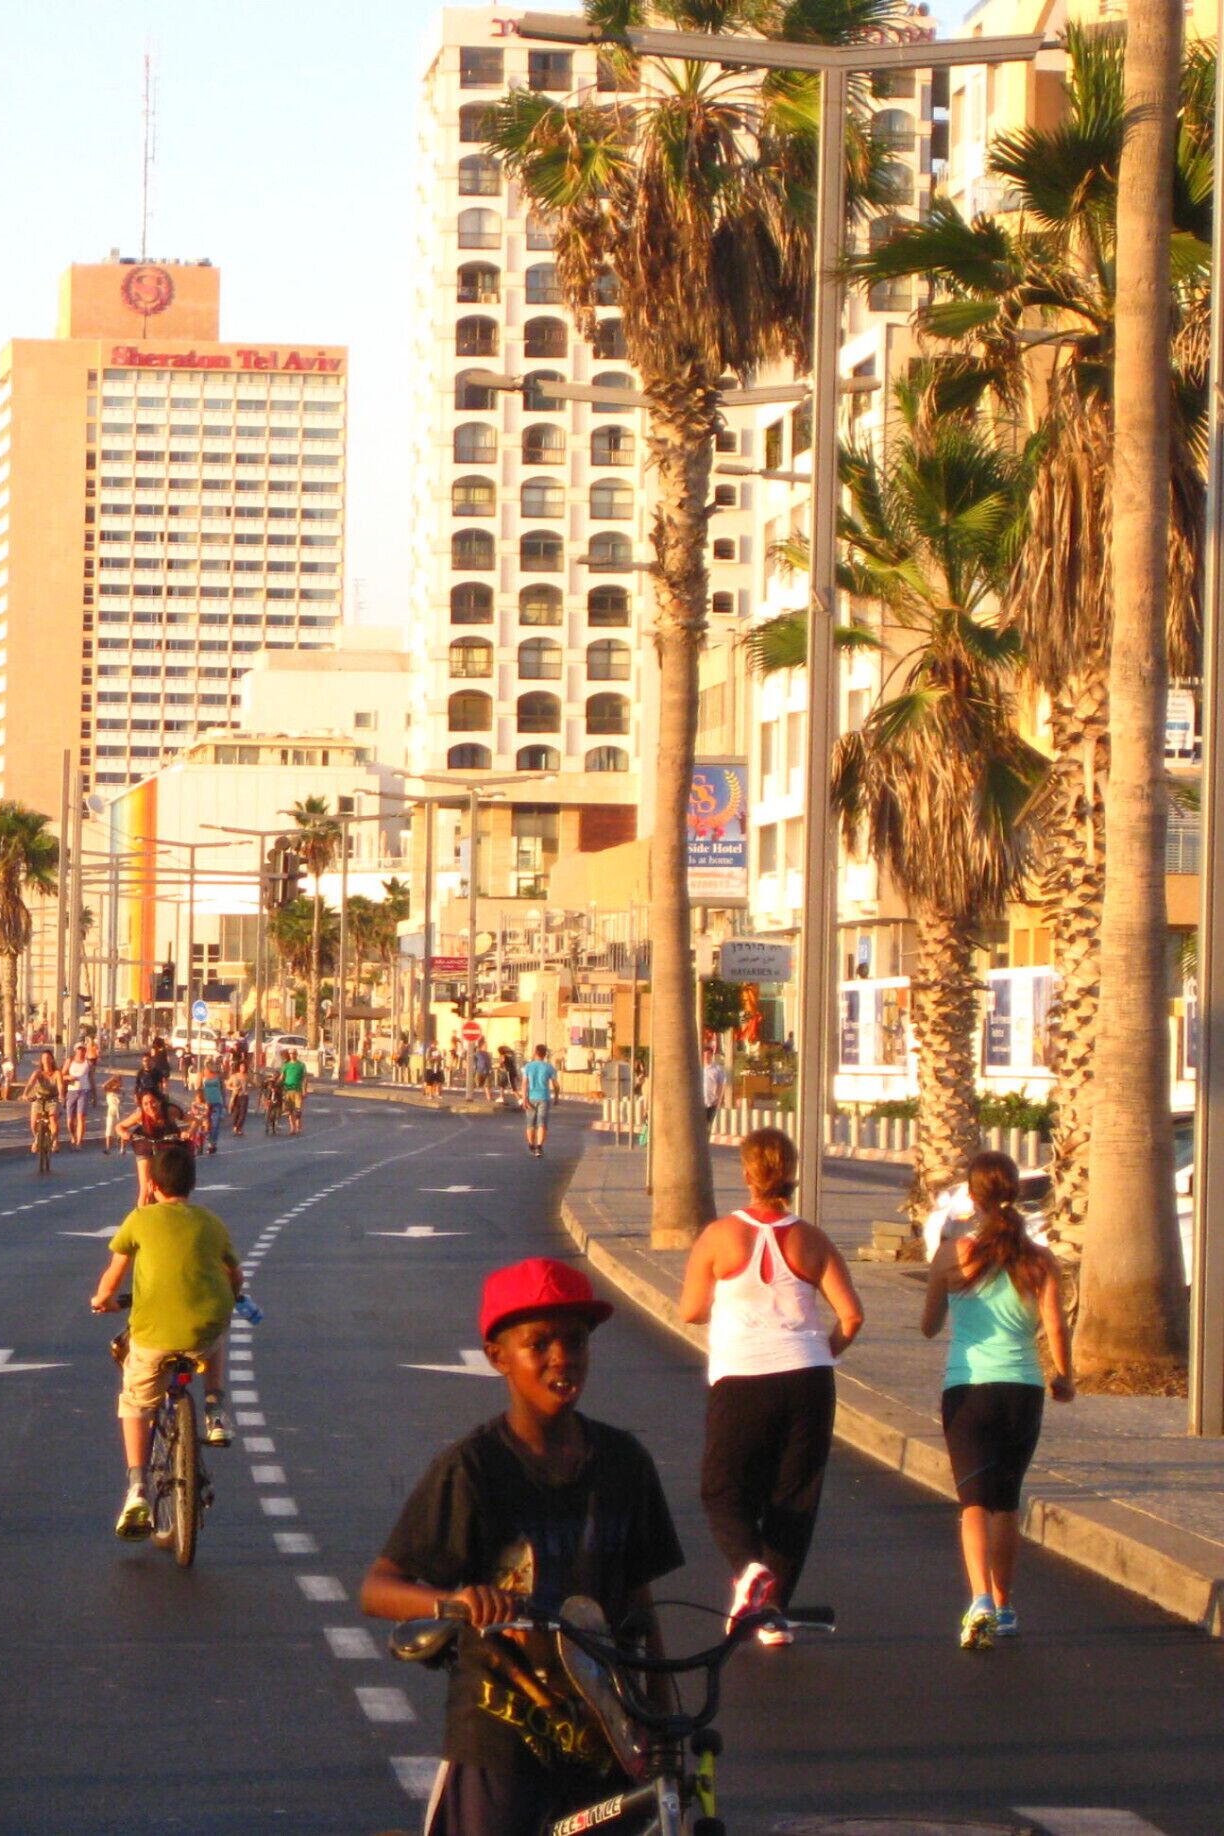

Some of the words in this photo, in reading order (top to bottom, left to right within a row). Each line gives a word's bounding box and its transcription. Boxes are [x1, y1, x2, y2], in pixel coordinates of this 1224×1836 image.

[111, 346, 231, 368] Sheraton
[237, 350, 277, 369] Tel
[282, 351, 344, 371] Aviv
[713, 843, 742, 853] Hotel
[709, 855, 733, 864] home
